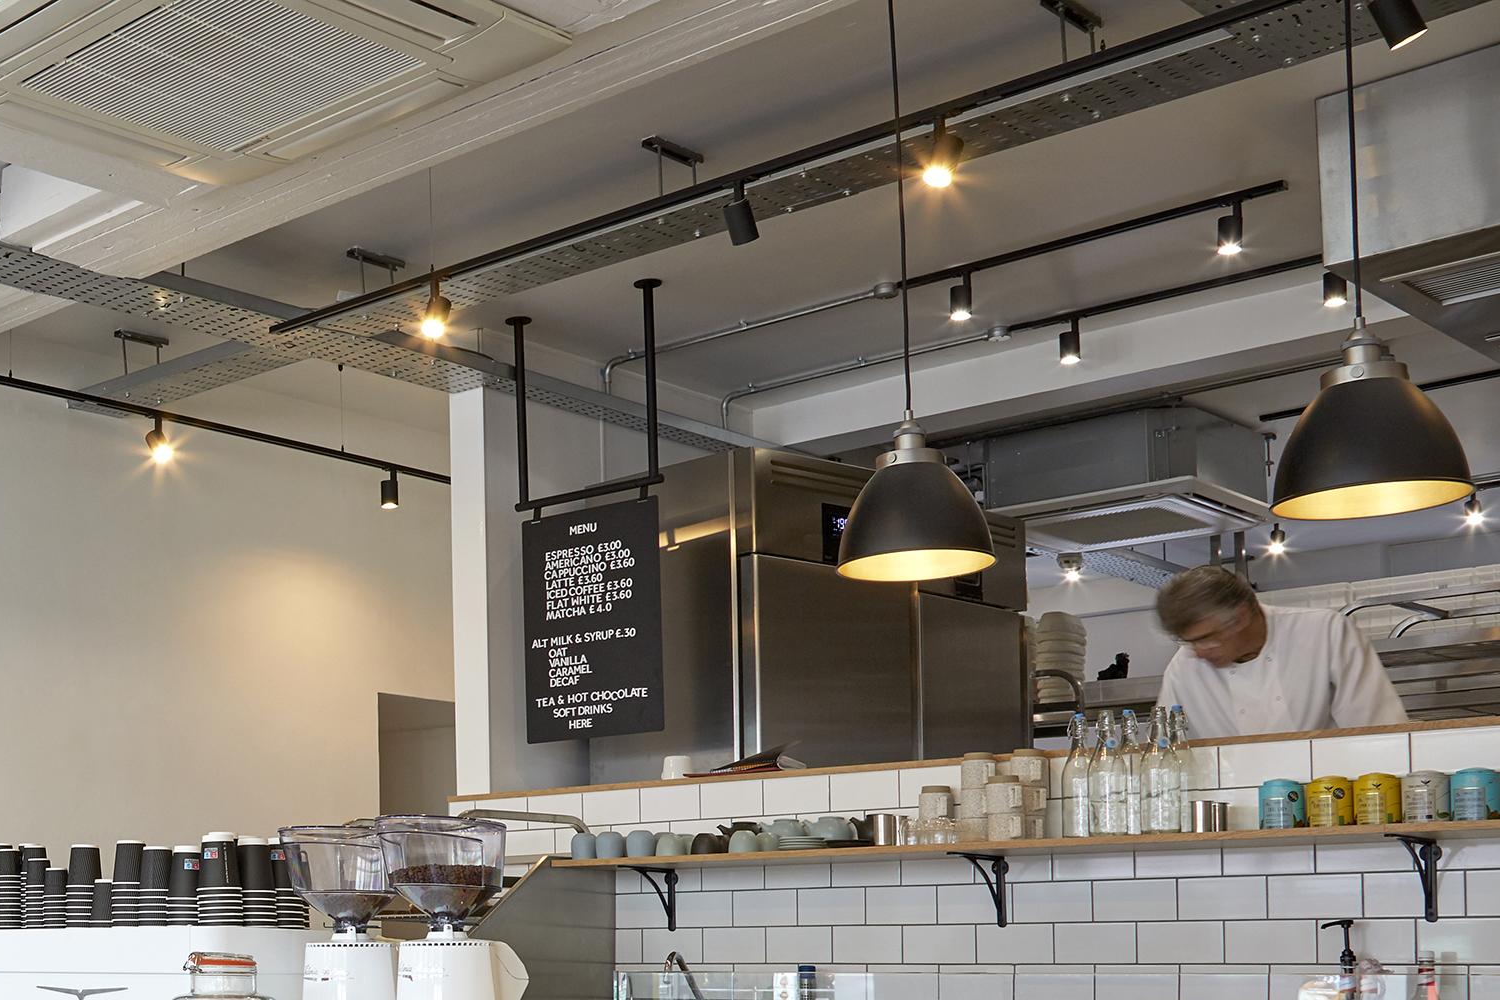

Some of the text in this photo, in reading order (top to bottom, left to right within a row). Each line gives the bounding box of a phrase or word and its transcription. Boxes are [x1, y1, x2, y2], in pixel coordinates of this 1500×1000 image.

[569, 522, 597, 536] MENU
[545, 539, 622, 562] ESPRESSO £3.00
[544, 548, 631, 571] AMERICANO £3.00
[543, 557, 635, 580] CAPPUCCINO £3.60
[545, 572, 603, 591] LATTE £3.60
[546, 577, 633, 600] ICED COFFEE £3.60
[546, 588, 632, 611] FLAT WHITE £3.60
[545, 605, 587, 621] MATCHA
[531, 638, 549, 649] ALT
[550, 634, 574, 647] MILK
[574, 633, 582, 644] &
[584, 629, 614, 643] SYRUP
[548, 647, 568, 659] OAT
[548, 654, 588, 668] VANILLA
[548, 664, 593, 678] CARAMEL
[549, 675, 580, 688] DECAF
[535, 687, 649, 708] TEA & HOT CHOCOLATE
[553, 703, 614, 718] SOFT DRINKS
[568, 718, 593, 730] HERE
